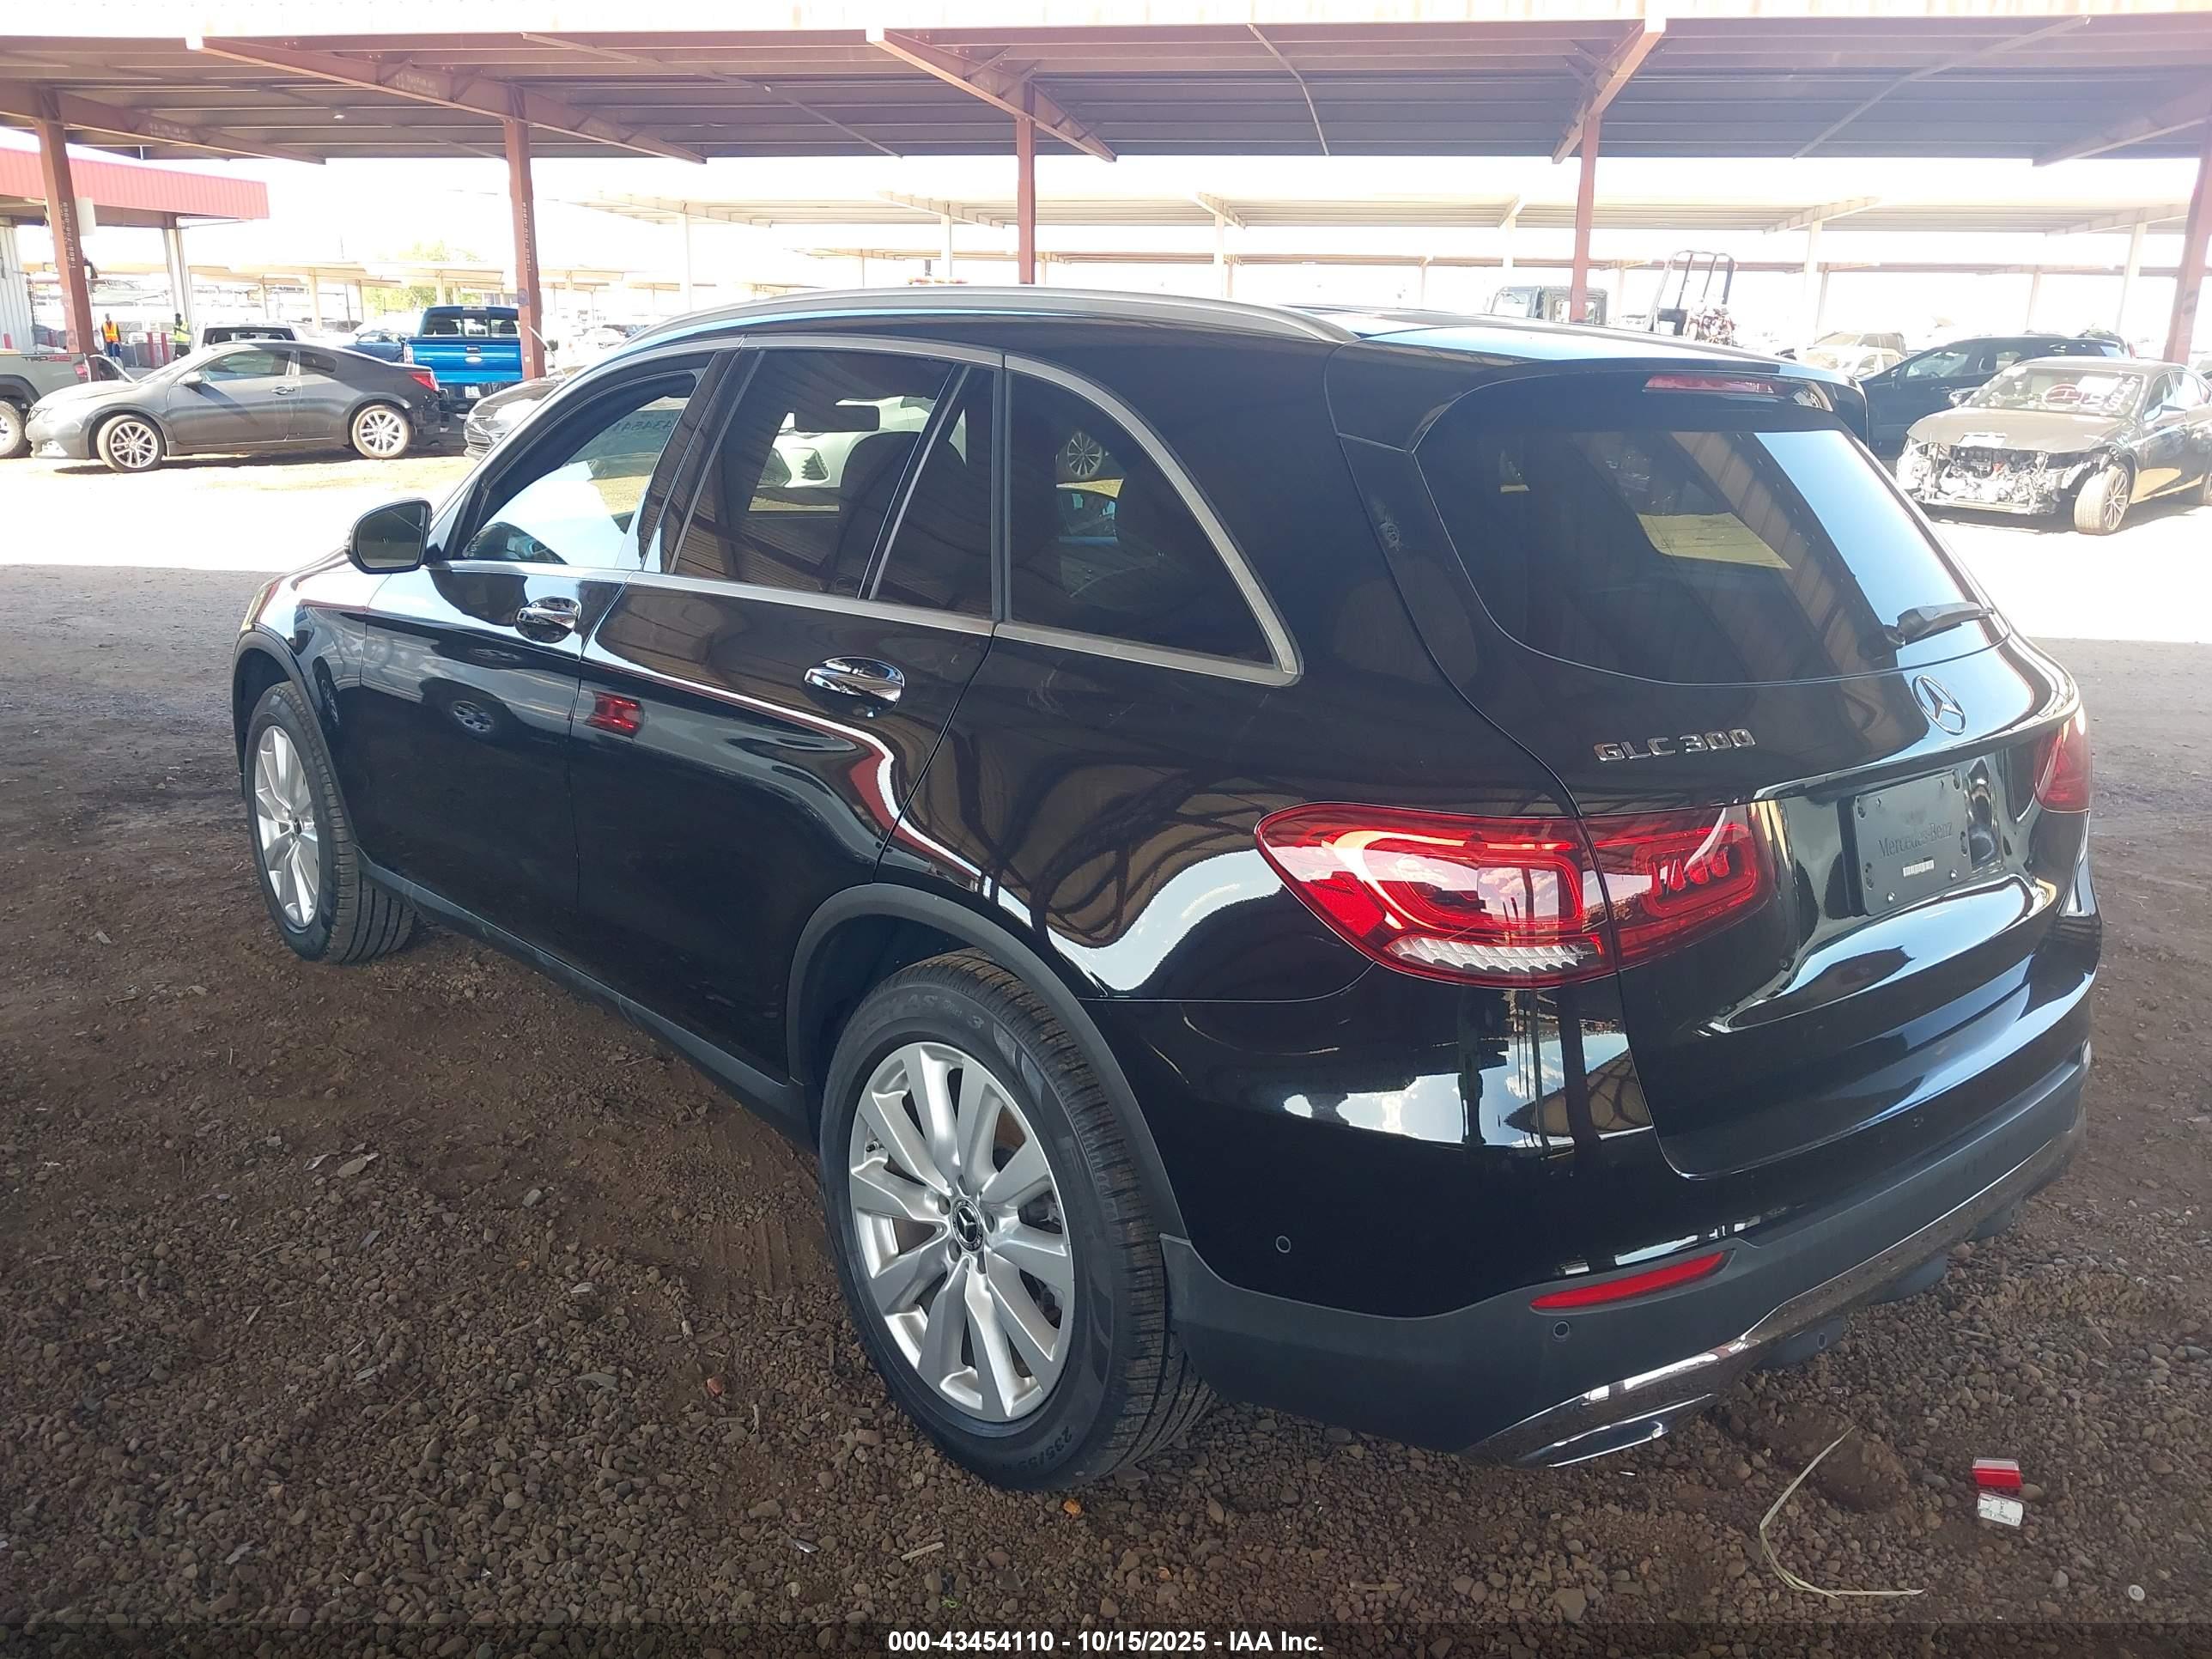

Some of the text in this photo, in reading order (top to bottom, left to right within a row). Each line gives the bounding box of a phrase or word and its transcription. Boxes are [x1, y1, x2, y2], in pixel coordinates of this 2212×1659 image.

[1594, 729, 1756, 762] GLC 300
[1877, 822, 1953, 857] Mercedes-Benz
